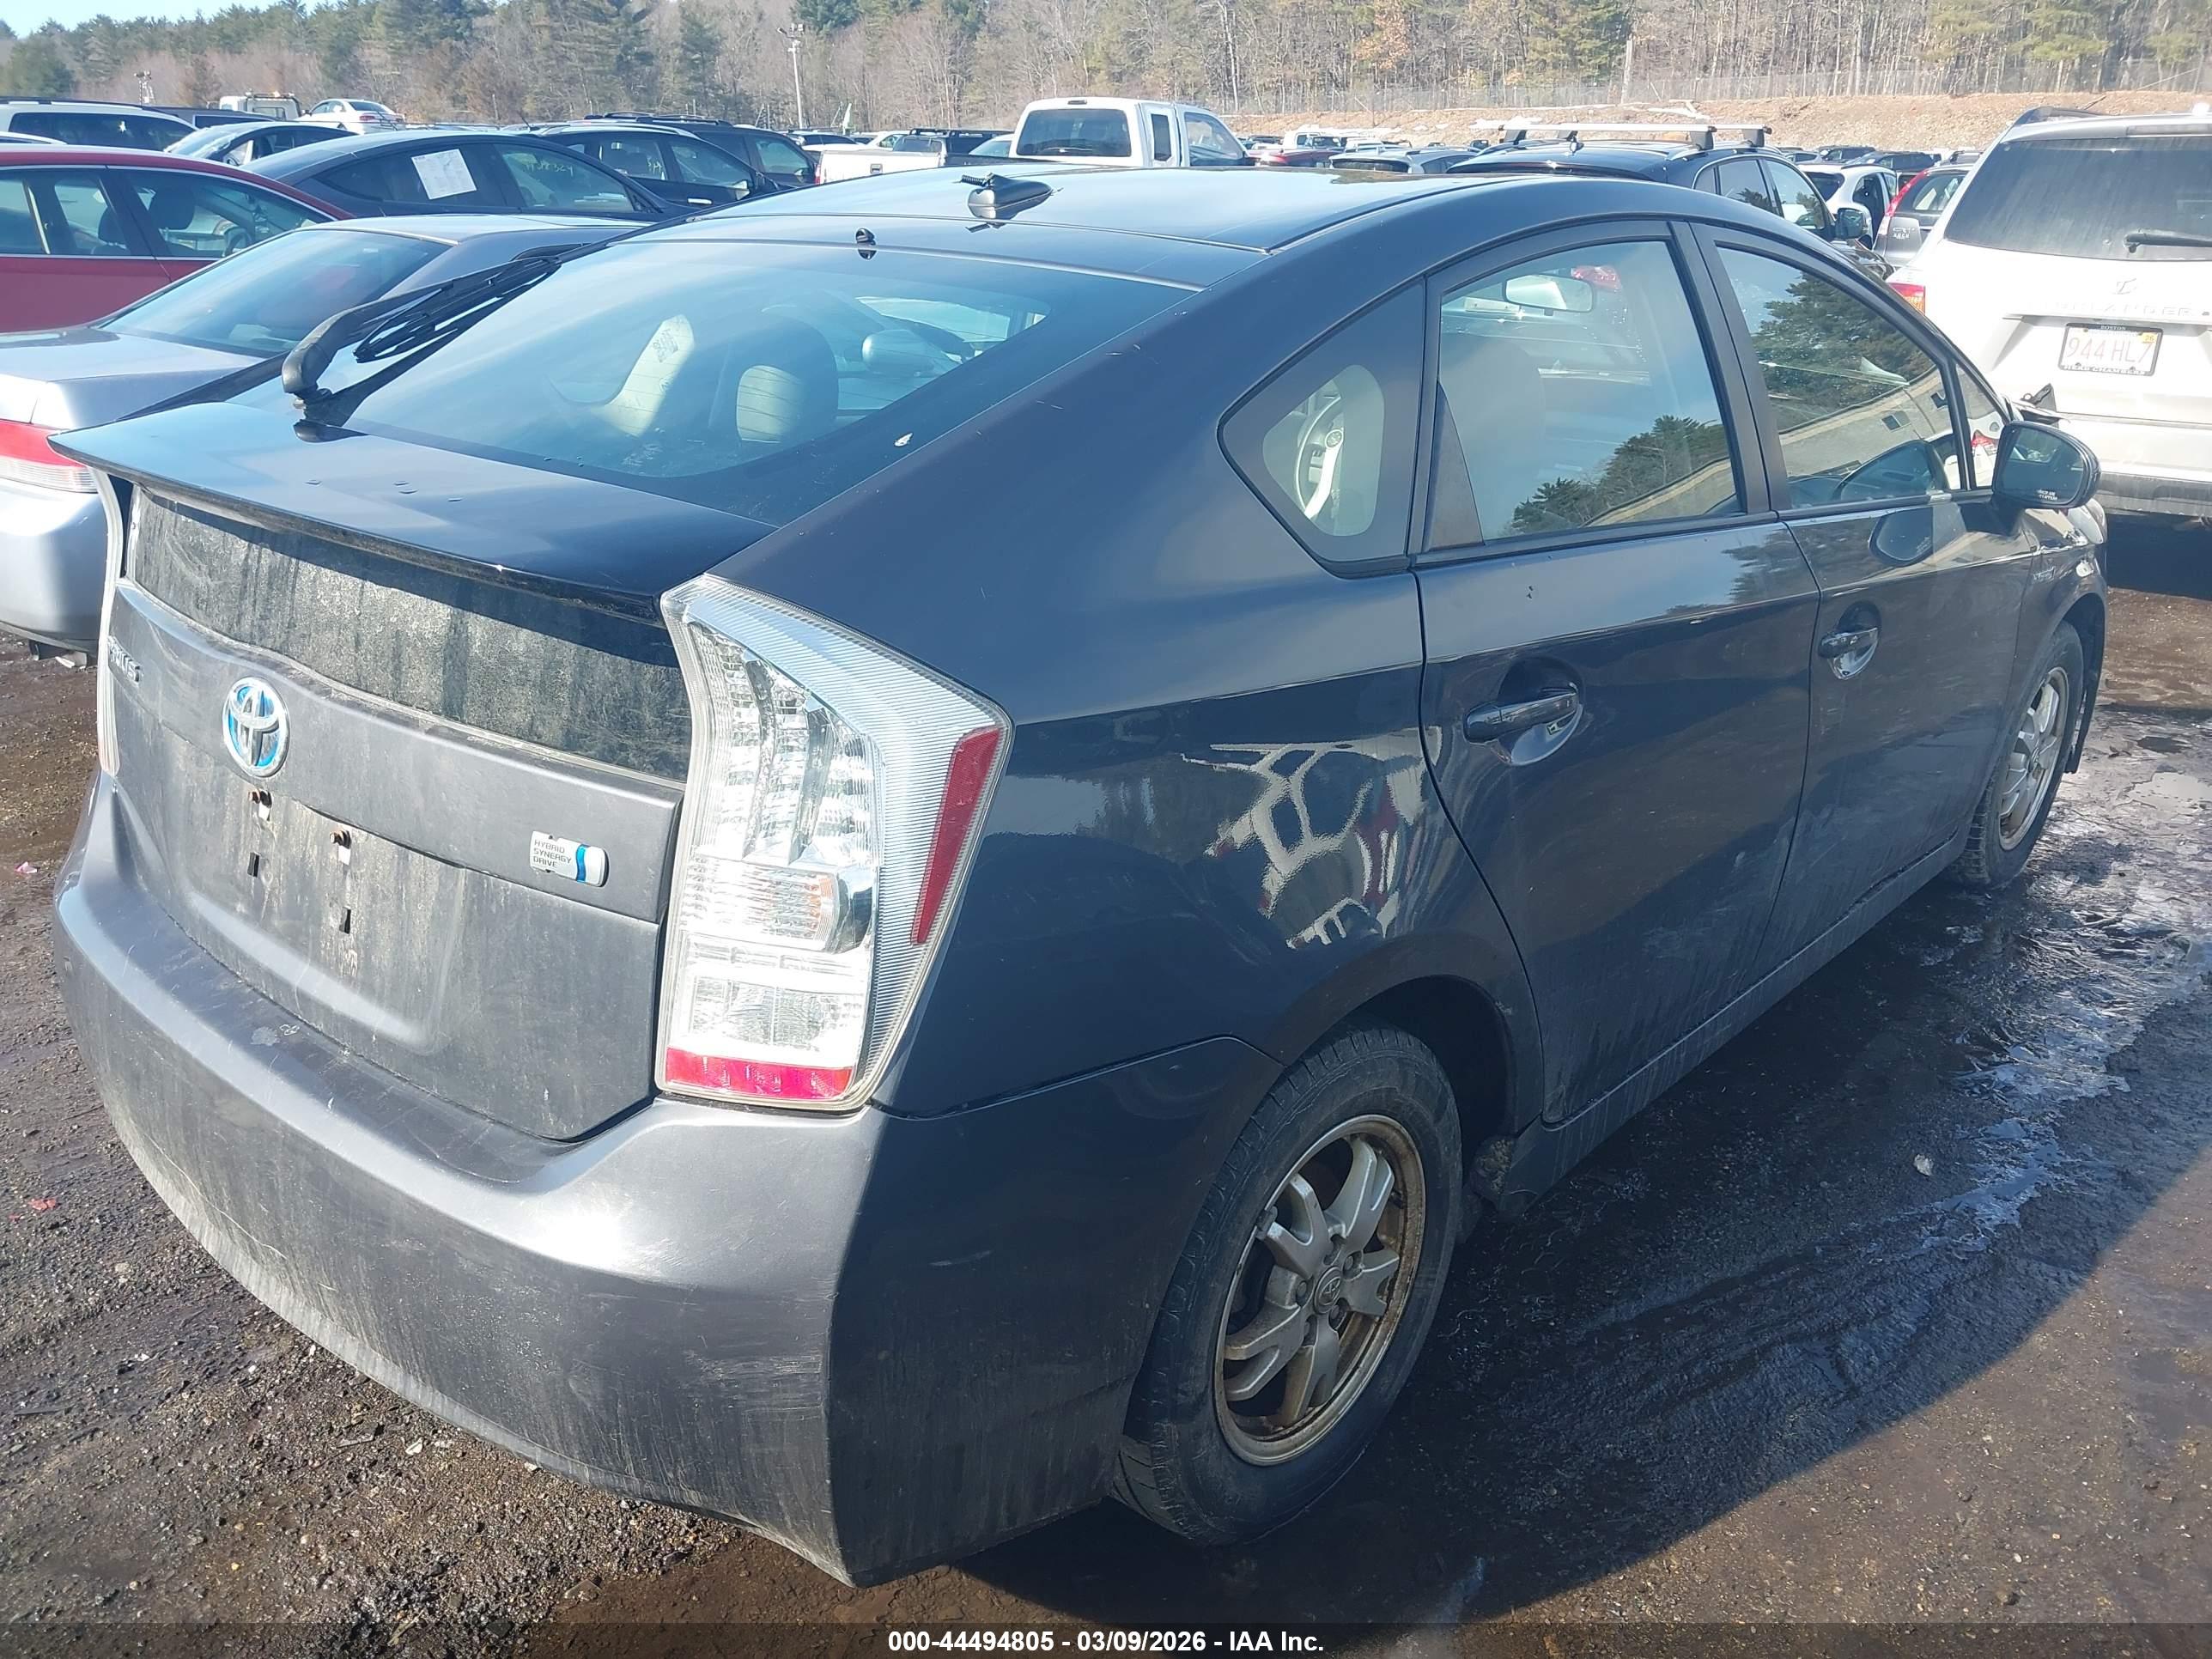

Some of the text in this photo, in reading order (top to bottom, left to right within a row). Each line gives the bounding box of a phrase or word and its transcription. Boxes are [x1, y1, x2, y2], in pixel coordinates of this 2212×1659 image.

[2067, 337, 2154, 364] 944 HL7
[534, 839, 565, 854] HYBRID
[533, 848, 572, 864] SYNERGY
[533, 856, 558, 868] DRIVE
